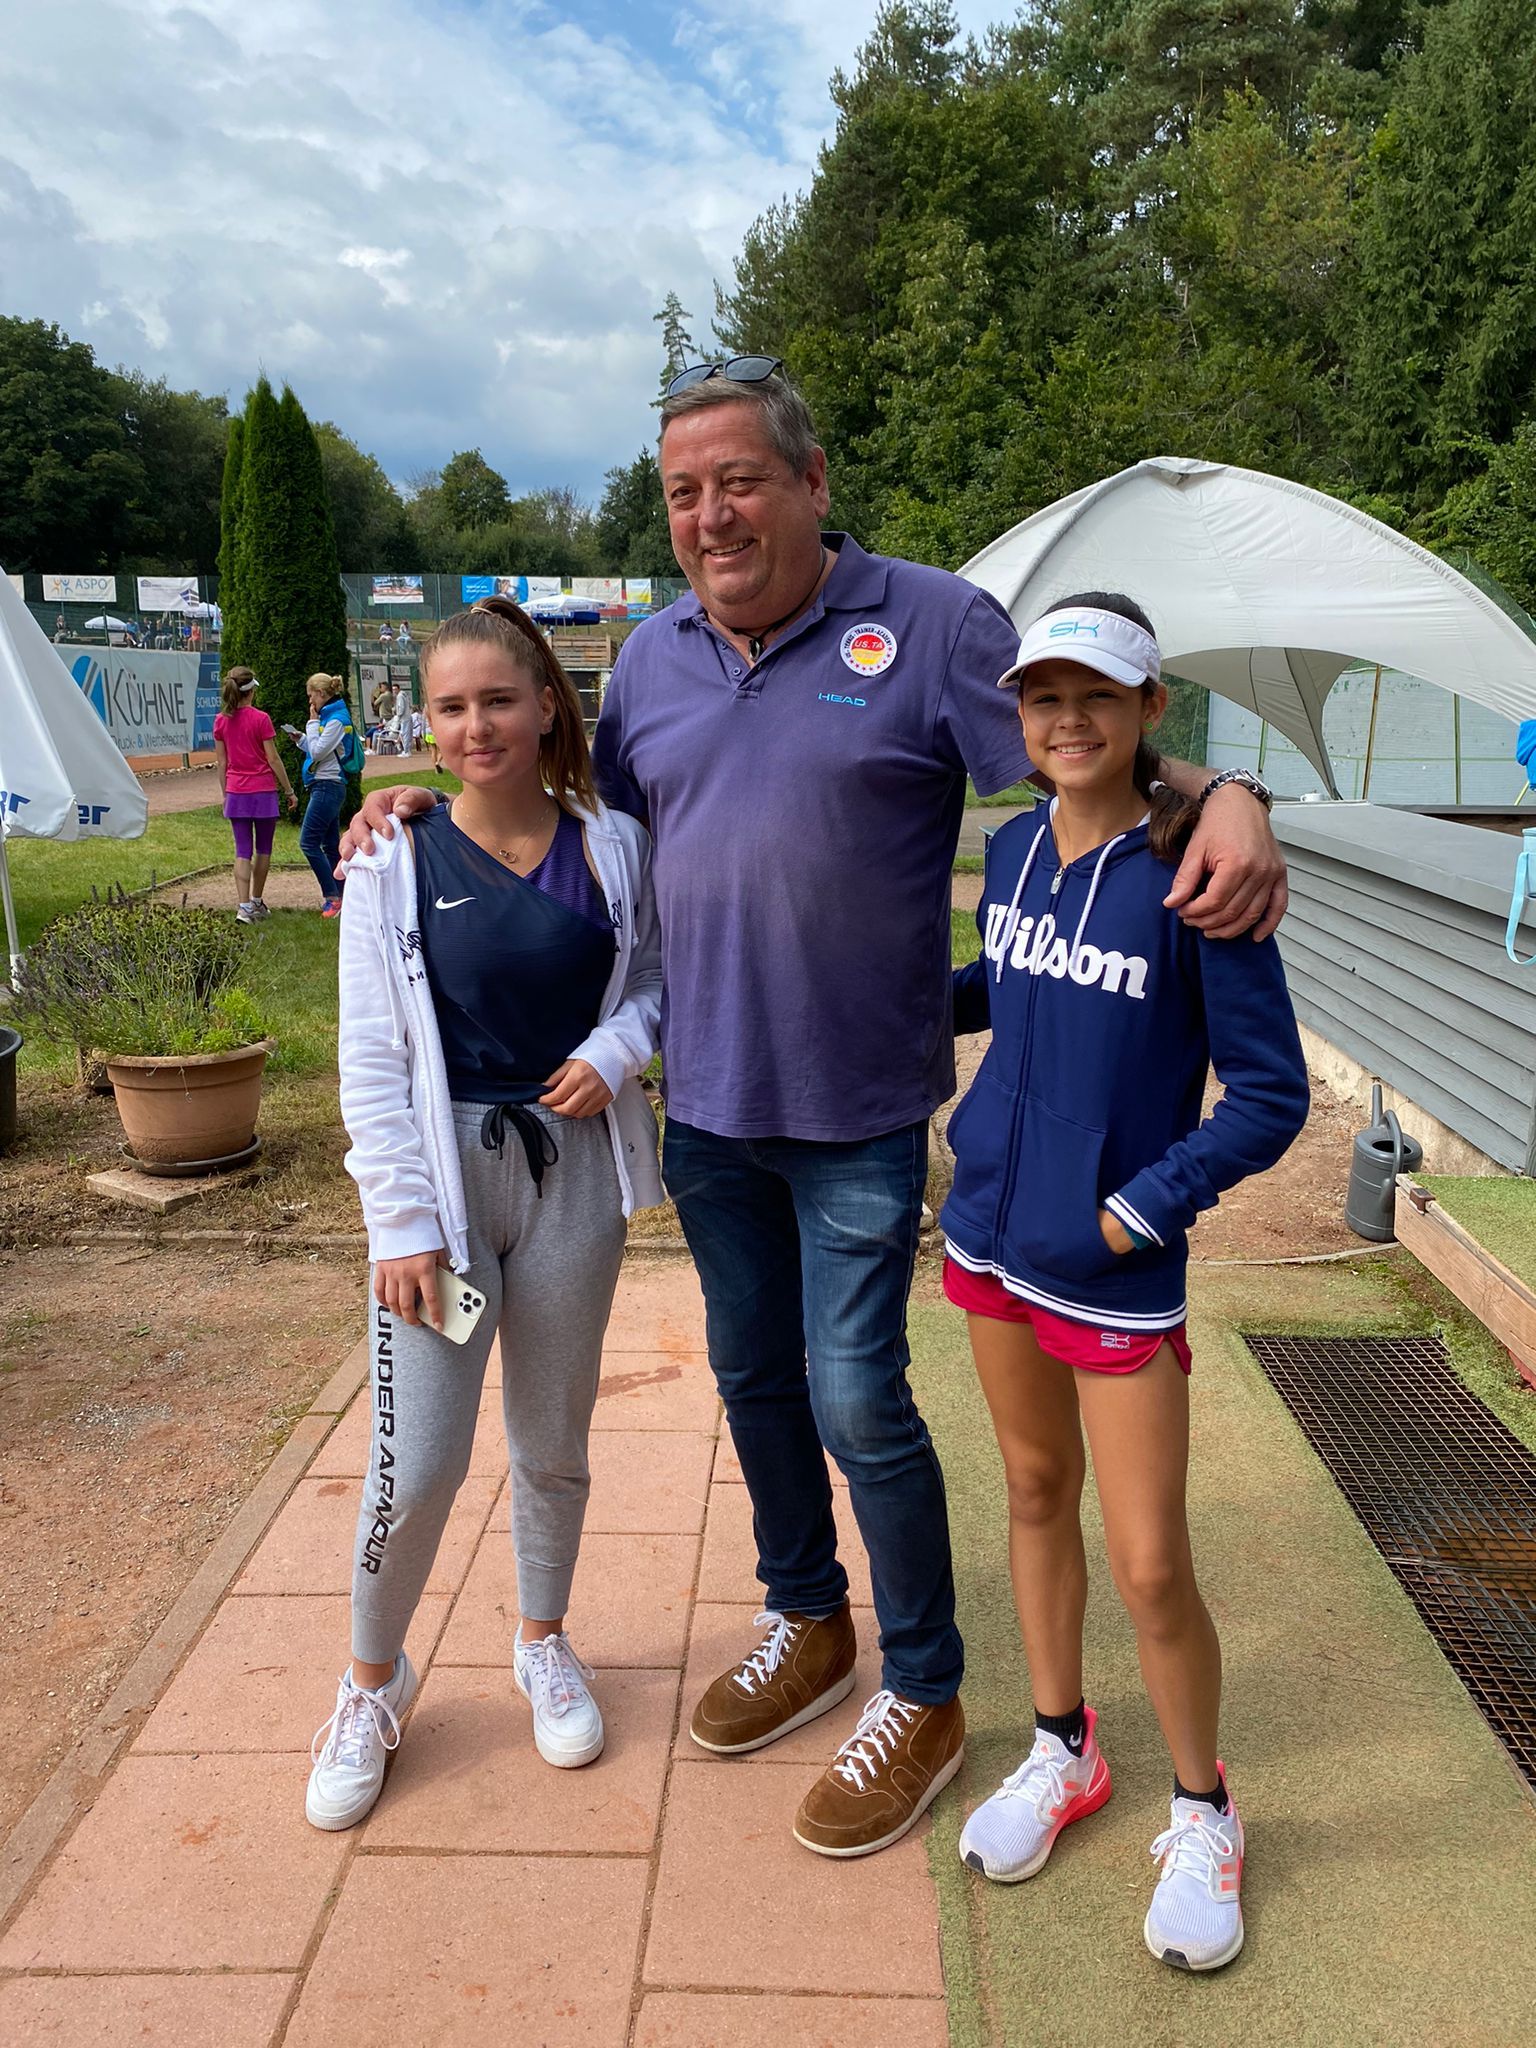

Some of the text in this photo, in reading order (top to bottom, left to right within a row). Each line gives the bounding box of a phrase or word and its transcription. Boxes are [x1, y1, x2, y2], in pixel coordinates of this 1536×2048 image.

[75, 578, 108, 590] ASPO
[854, 627, 875, 635] TRAINER
[104, 668, 187, 727] KÜHNE
[818, 692, 867, 707] HEAD
[136, 734, 144, 749] &
[145, 731, 190, 748] Werbetechnik
[984, 903, 1148, 1000] Wilson
[378, 1305, 395, 1438] UNDER
